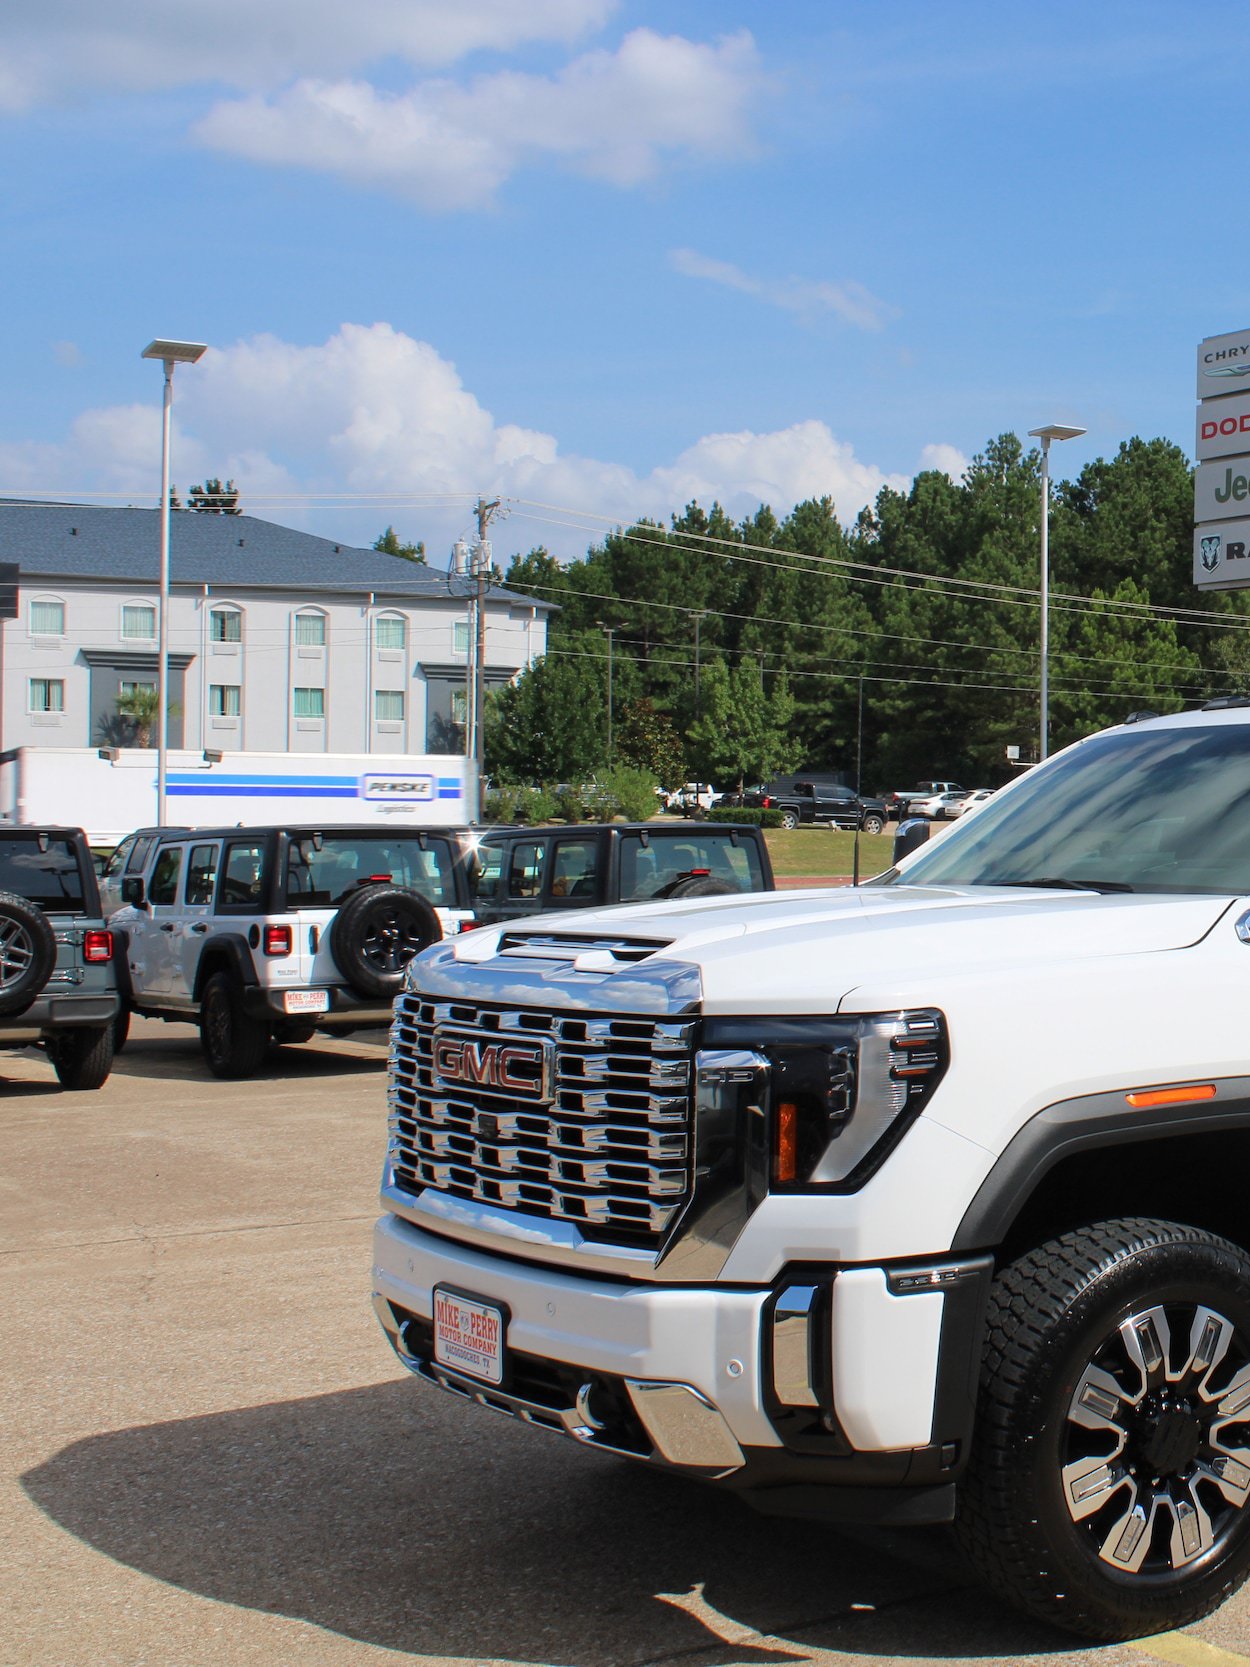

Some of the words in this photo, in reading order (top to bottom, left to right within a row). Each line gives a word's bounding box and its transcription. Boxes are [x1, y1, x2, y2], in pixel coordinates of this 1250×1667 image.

[368, 782, 430, 792] PENSKE
[434, 1037, 541, 1092] GMC
[437, 1300, 460, 1329] MIKE
[470, 1312, 499, 1342] PERRY
[439, 1325, 462, 1343] MOTOR
[463, 1333, 497, 1356] COMPANY
[482, 1357, 491, 1369] TX
